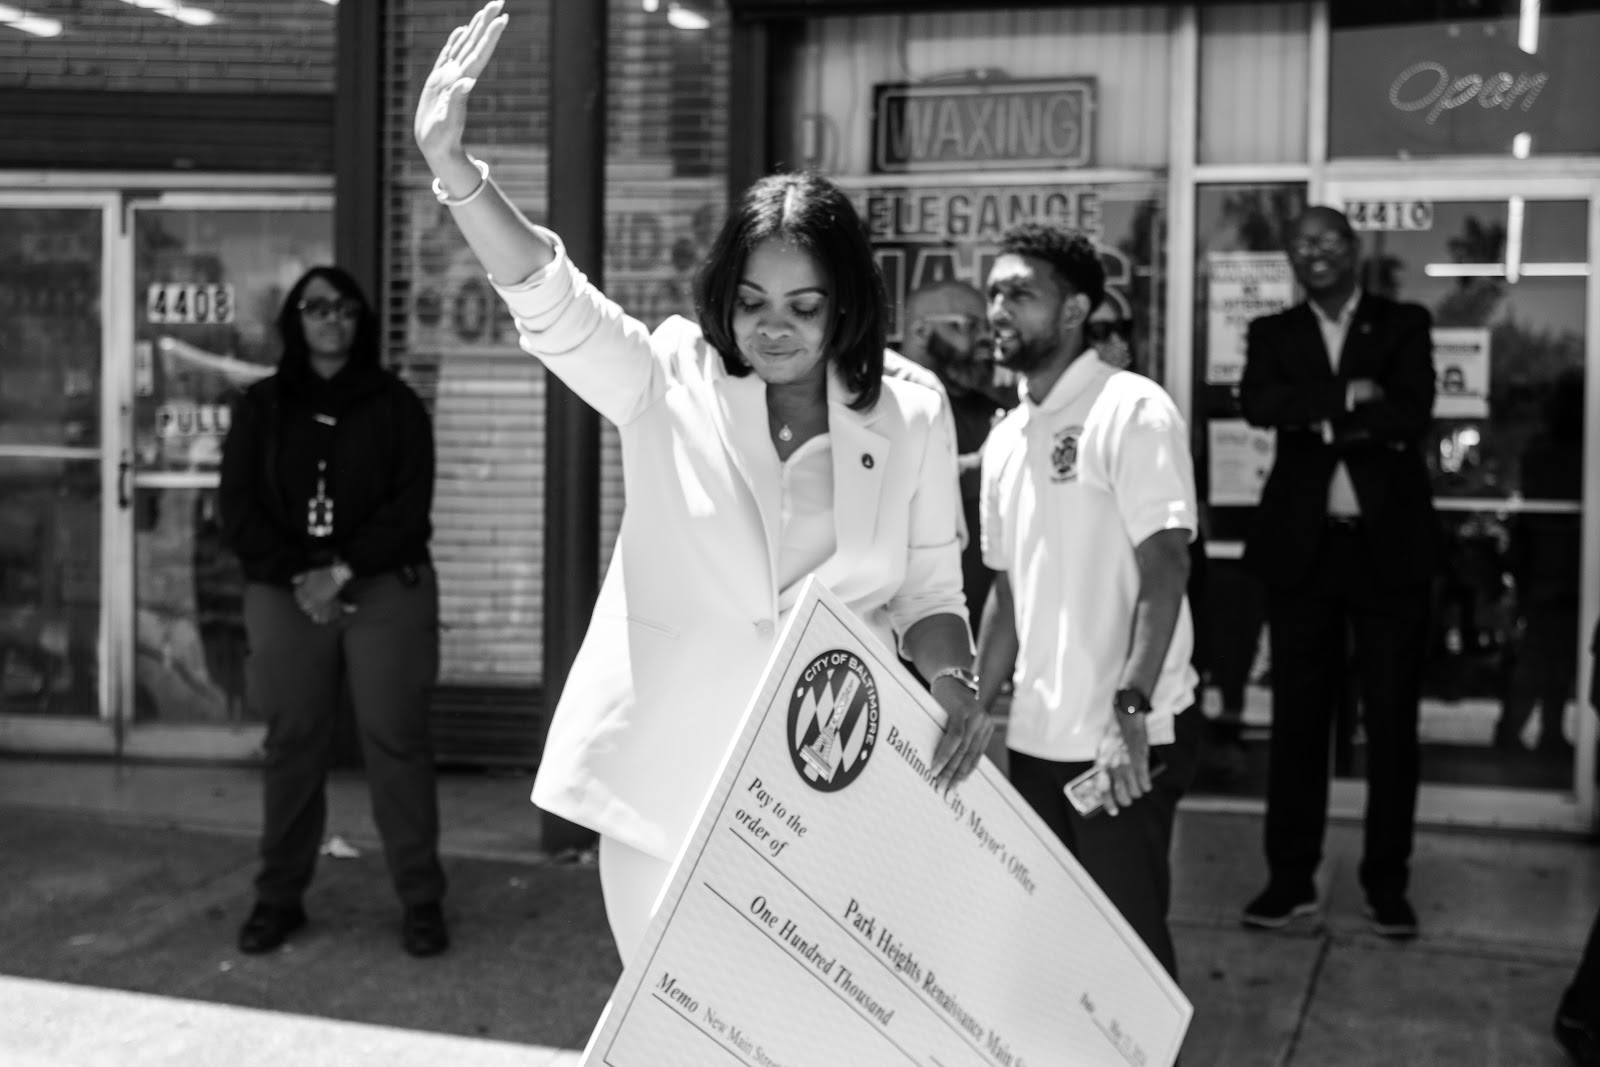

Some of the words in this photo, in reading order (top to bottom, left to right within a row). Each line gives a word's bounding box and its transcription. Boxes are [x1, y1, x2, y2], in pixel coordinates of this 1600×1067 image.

[1388, 61, 1549, 125] Open
[888, 93, 1079, 160] WAXING
[867, 190, 1099, 238] ELEGANCE
[1351, 203, 1430, 227] 4410
[154, 289, 230, 322] 4408
[159, 411, 229, 434] PULL
[803, 655, 829, 683] CITY
[831, 652, 848, 666] OF
[848, 658, 879, 747] BALTIMORE
[735, 808, 771, 842] order
[770, 839, 791, 858] of
[747, 777, 774, 808] Pay
[772, 801, 788, 820] to
[786, 814, 808, 838] the
[942, 786, 966, 822] City
[967, 809, 1006, 865] Mayor's
[1007, 856, 1037, 896] Office
[750, 896, 778, 928] One
[778, 919, 837, 975] Hundred
[833, 964, 896, 1027] Thousand
[844, 897, 877, 941] Park
[876, 928, 922, 984] Heights
[921, 969, 985, 1043] Renaissance
[656, 972, 700, 1014] Memo
[703, 1005, 728, 1035] New
[727, 1025, 754, 1057] Main
